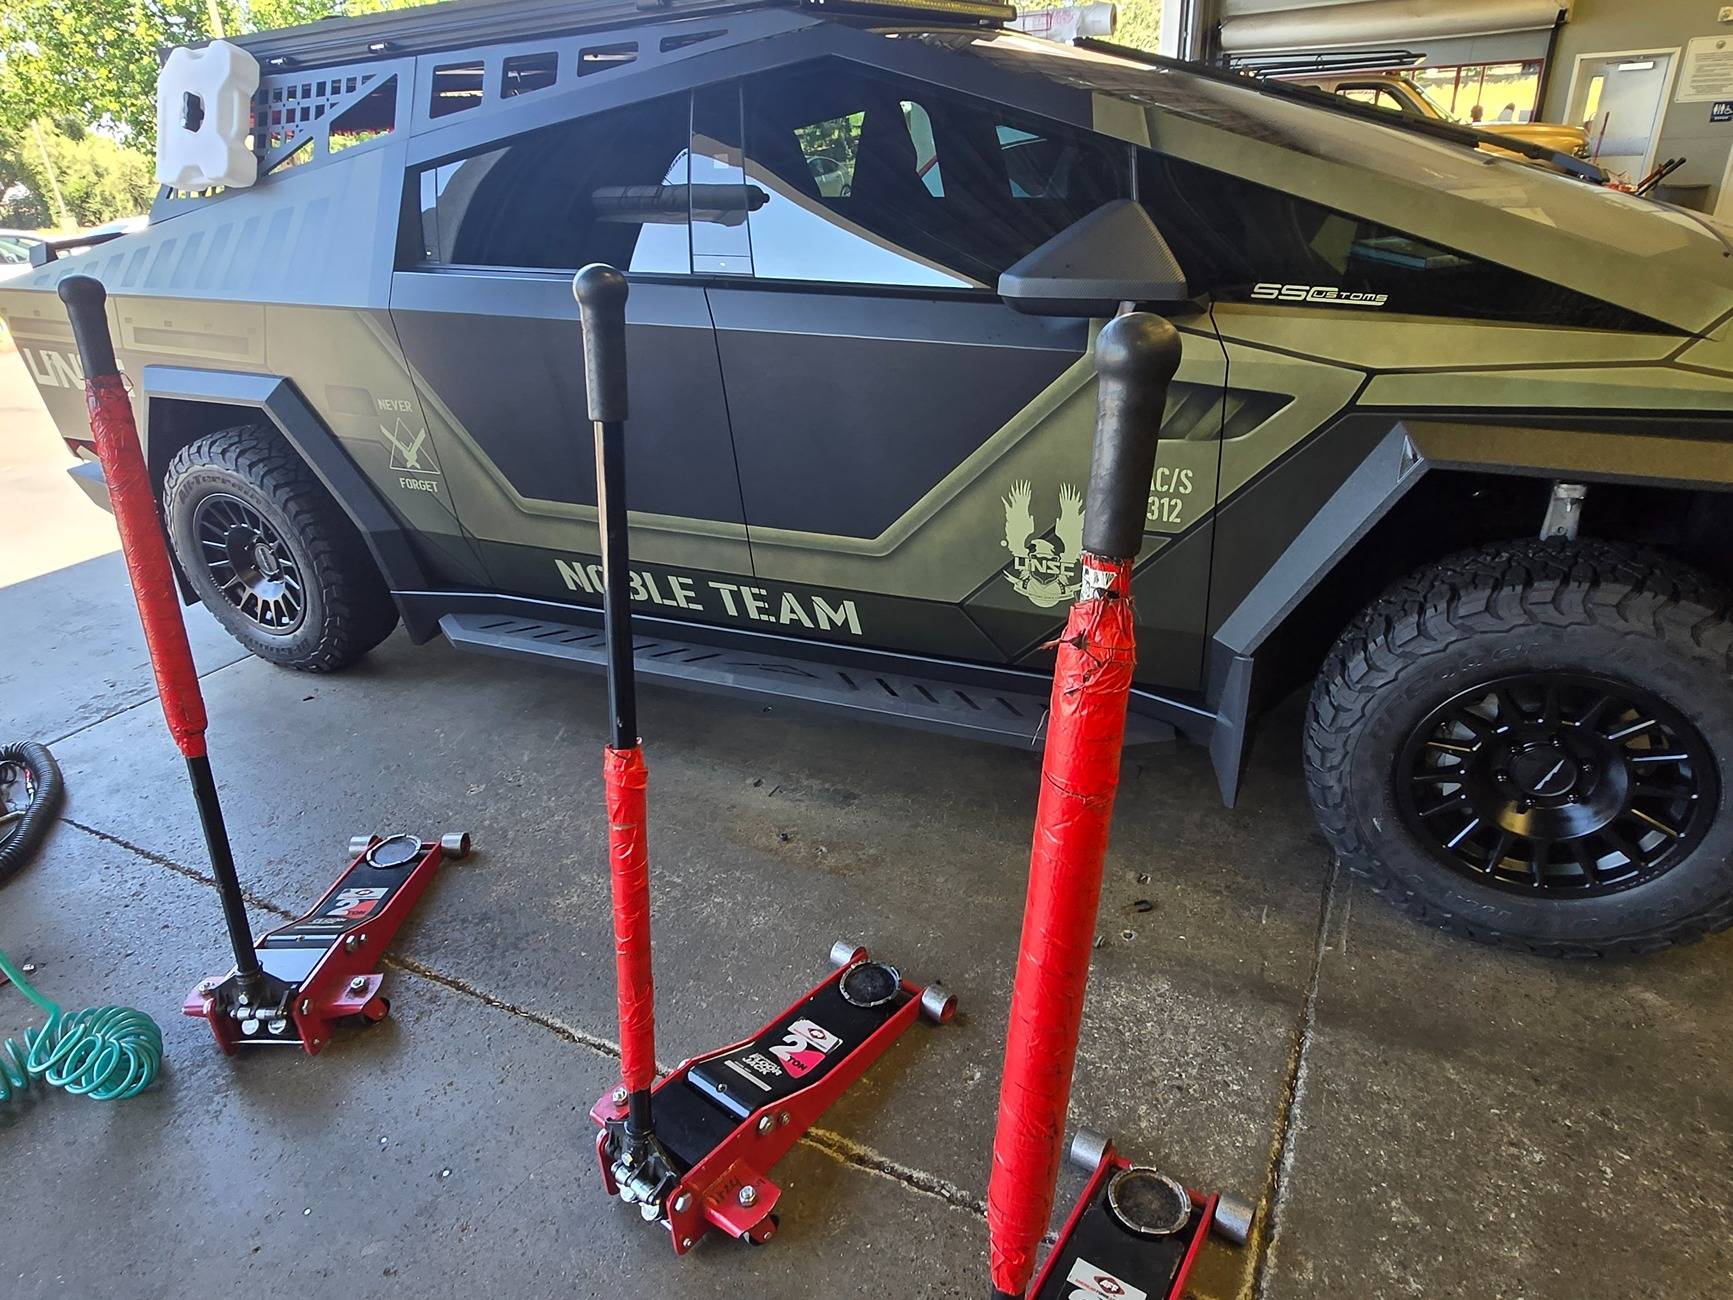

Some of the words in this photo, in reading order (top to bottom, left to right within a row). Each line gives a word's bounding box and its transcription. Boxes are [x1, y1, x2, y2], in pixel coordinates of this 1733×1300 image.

[377, 398, 412, 412] NEVER
[399, 477, 438, 493] FORGET
[1146, 496, 1183, 523] 312
[1014, 556, 1075, 577] UNSC
[707, 580, 863, 636] TEAM
[326, 898, 360, 915] 2
[768, 1034, 808, 1062] 2
[786, 1055, 807, 1072] TON
